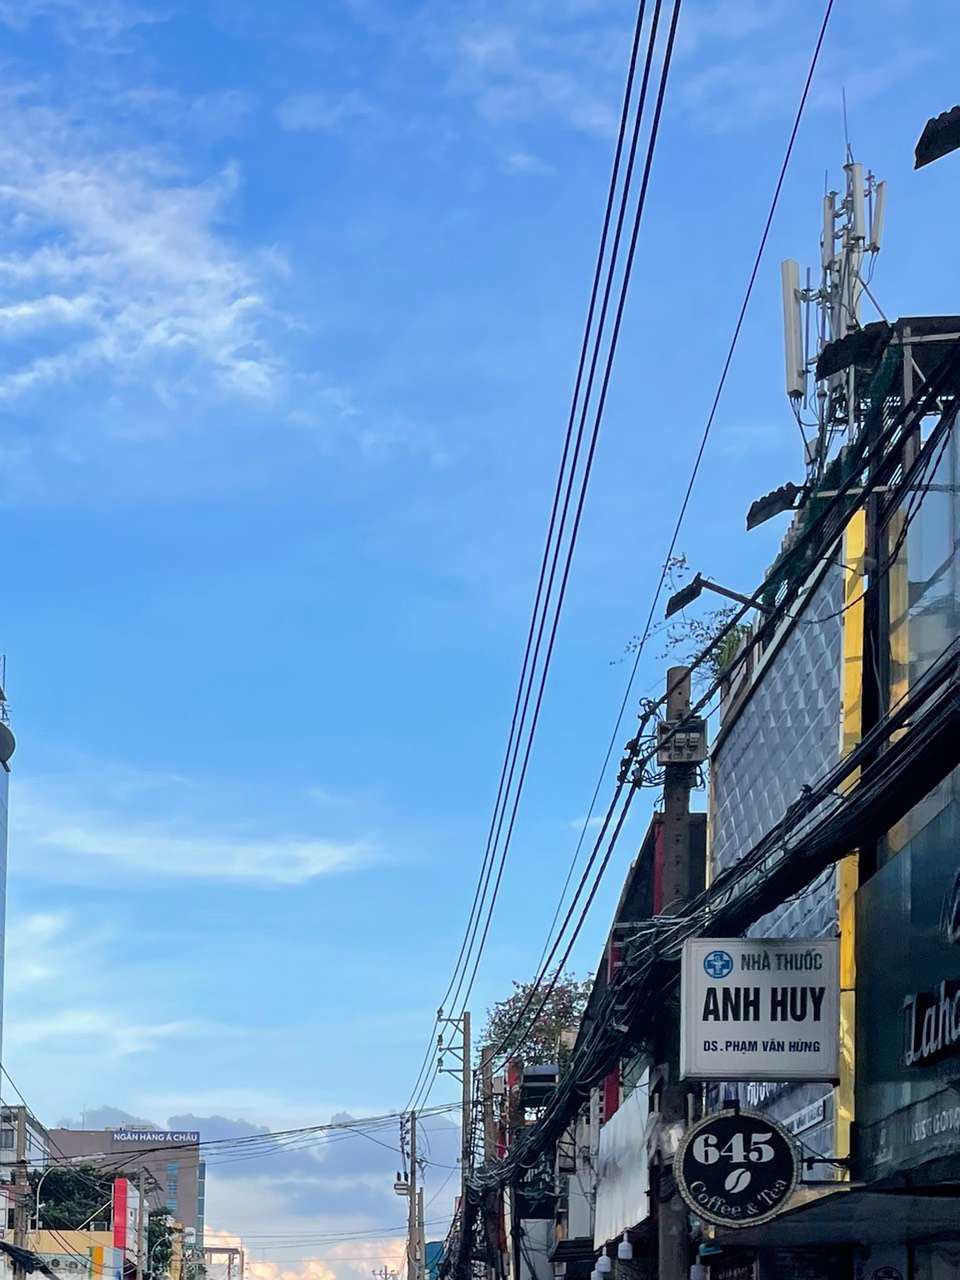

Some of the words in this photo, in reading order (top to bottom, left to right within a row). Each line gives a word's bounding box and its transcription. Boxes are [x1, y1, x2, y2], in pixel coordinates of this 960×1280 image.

[740, 951, 771, 971] NHÀ
[775, 947, 823, 971] THUỐC
[701, 986, 761, 1022] ANH
[770, 986, 826, 1022] HUY
[725, 1040, 758, 1055] PHẠM
[762, 1037, 785, 1052] VĂN
[788, 1037, 820, 1053] HÙNG
[113, 1131, 138, 1141] NGÂN
[139, 1131, 164, 1141] HÀNG
[173, 1131, 198, 1141] CHÂU
[692, 1132, 776, 1165] 645
[690, 1181, 742, 1217] Coffee
[746, 1202, 759, 1215] &
[757, 1178, 788, 1205] Tea
